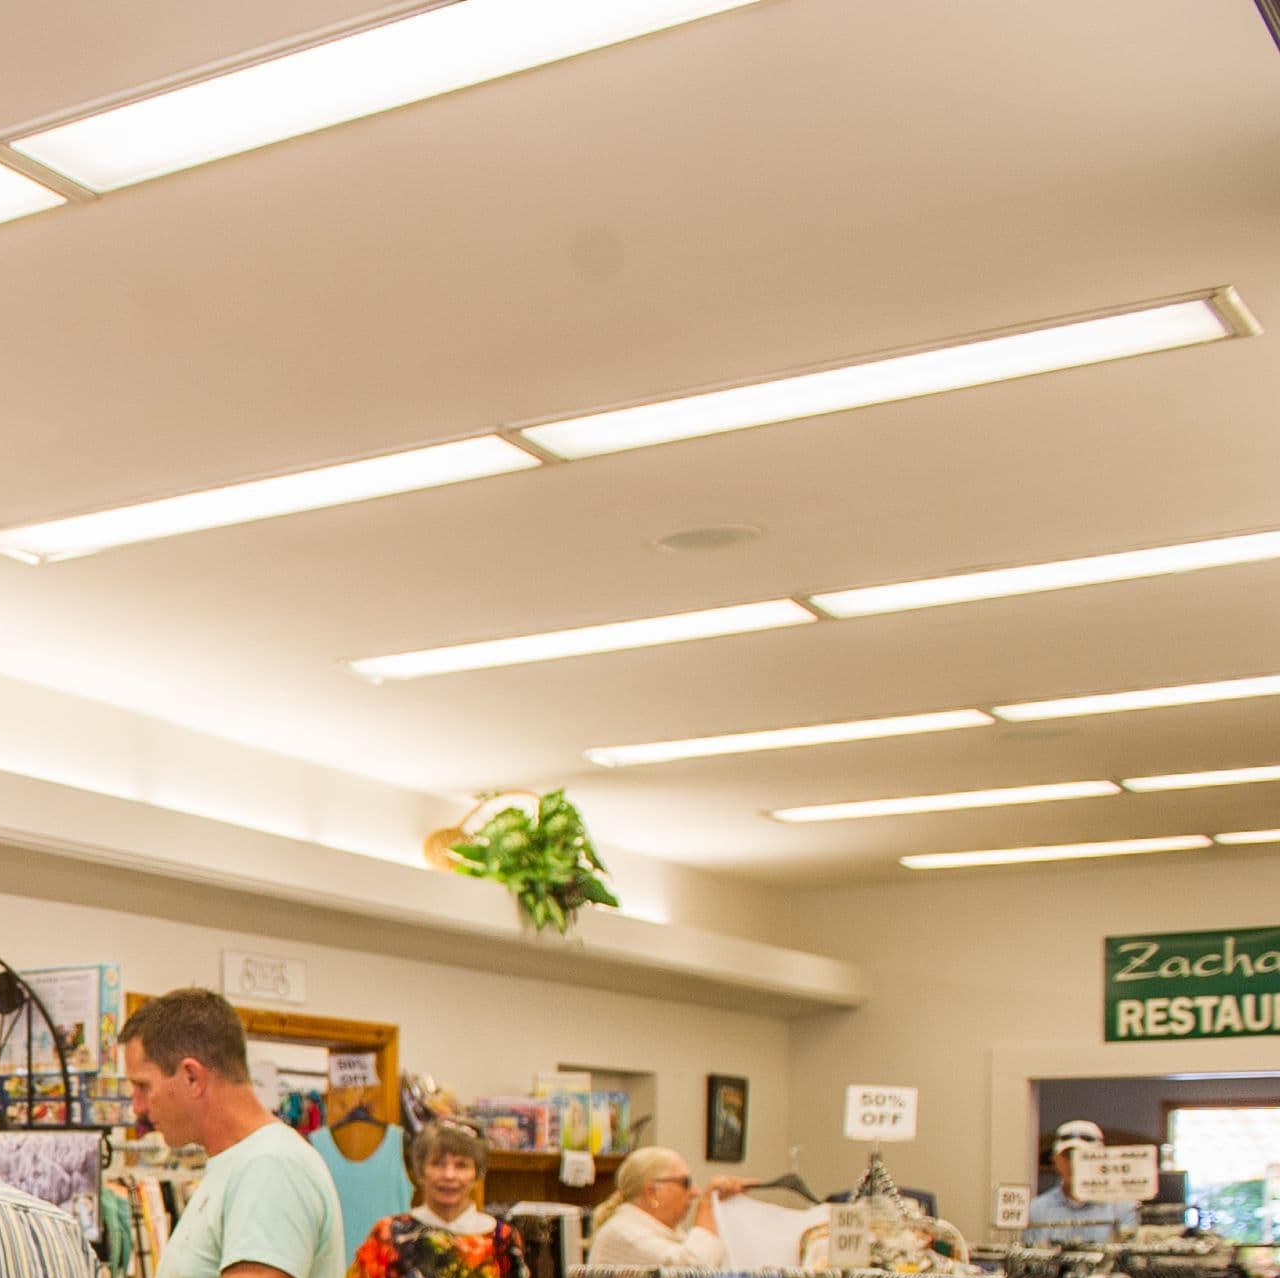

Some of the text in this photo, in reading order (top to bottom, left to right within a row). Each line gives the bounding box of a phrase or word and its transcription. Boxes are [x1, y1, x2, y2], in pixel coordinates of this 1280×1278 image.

[1117, 992, 1280, 1037] RESTAU
[861, 1091, 905, 1109] 50%
[861, 1111, 903, 1126] OFF
[837, 1234, 861, 1250] OFF
